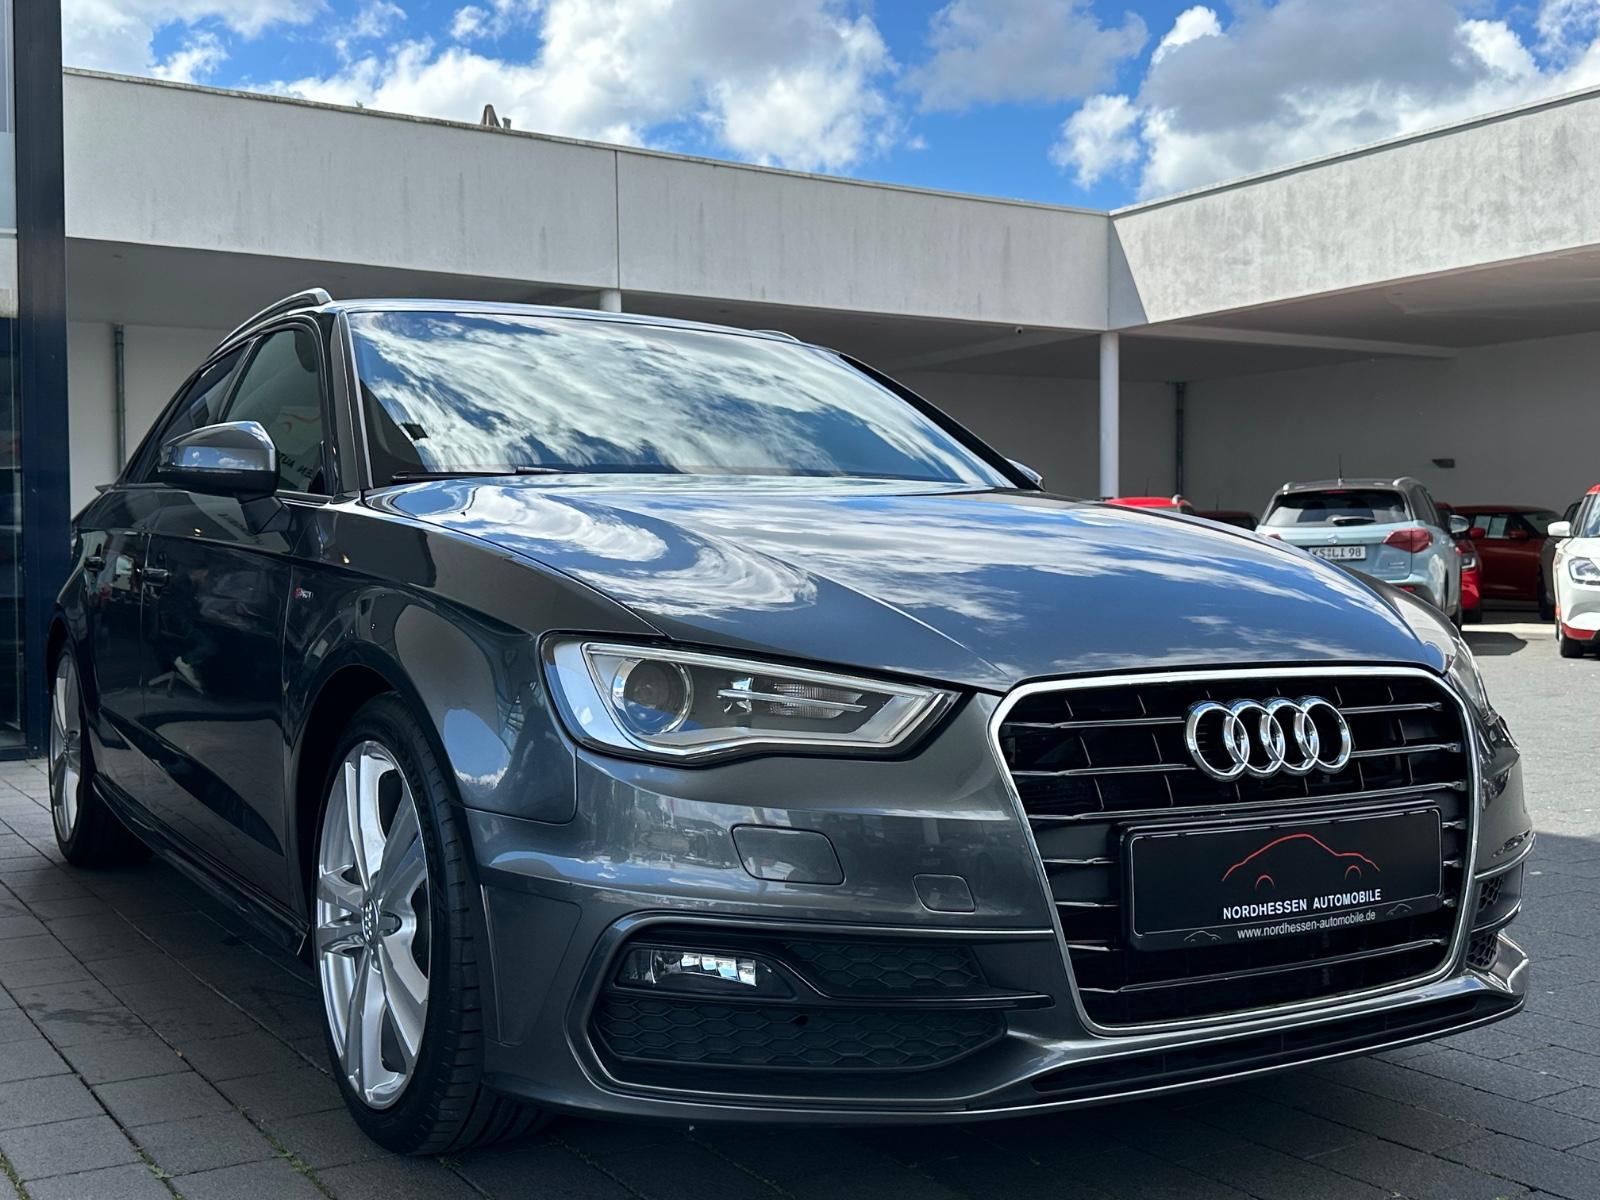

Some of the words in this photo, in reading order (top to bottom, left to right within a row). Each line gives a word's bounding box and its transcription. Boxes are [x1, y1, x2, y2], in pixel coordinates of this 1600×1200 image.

[1348, 547, 1362, 557] 98
[1223, 899, 1307, 920] NORDHESSEN
[1313, 889, 1381, 909] AUTOMOBILE
[1237, 910, 1376, 939] www.nordhessen-automobile.de
